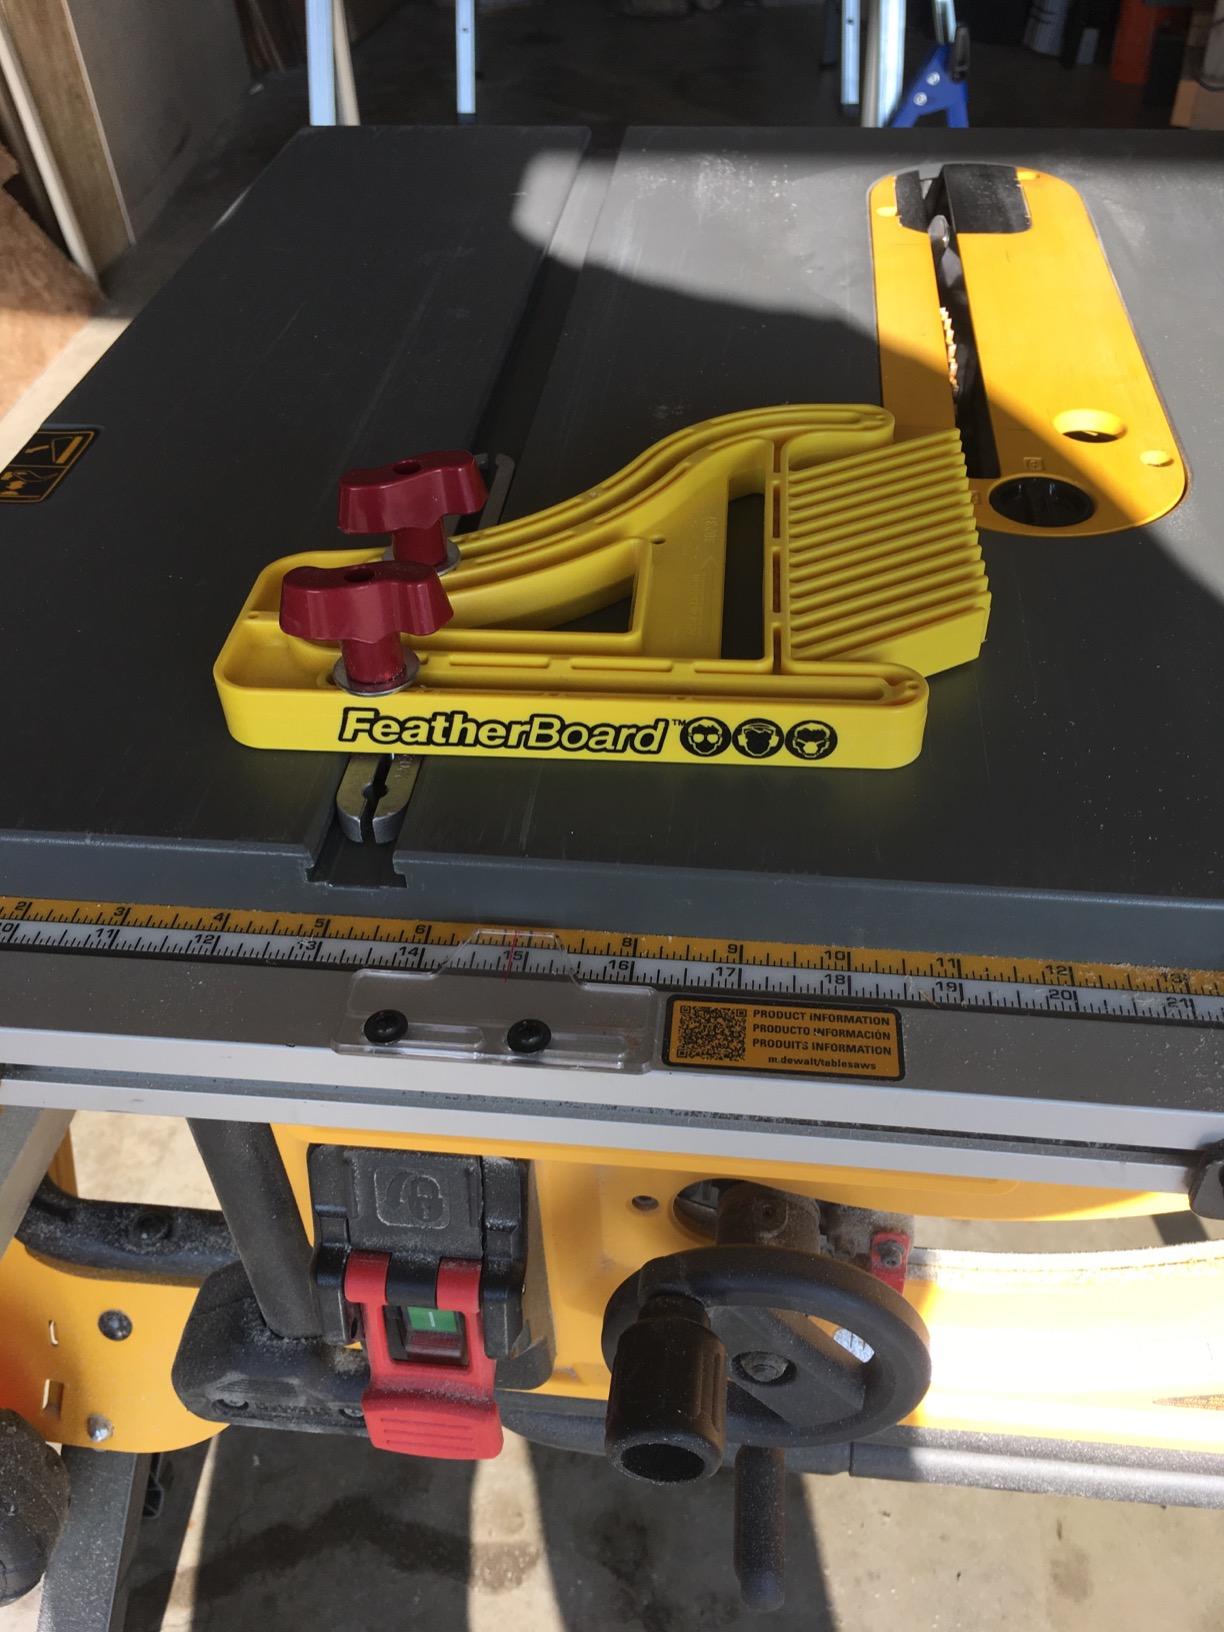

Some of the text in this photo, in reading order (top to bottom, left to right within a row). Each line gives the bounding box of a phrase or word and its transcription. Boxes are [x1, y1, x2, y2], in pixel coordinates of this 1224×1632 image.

[338, 707, 669, 754] FeatherBoard
[15, 901, 27, 911] 2
[114, 907, 126, 917] 3
[213, 912, 225, 922] 4
[314, 918, 326, 928] 5
[415, 925, 426, 935] 6
[621, 937, 632, 947] 8
[727, 944, 738, 955] 9
[824, 950, 846, 961] 10
[936, 957, 957, 968] 11
[1045, 965, 1068, 976] 12
[95, 928, 115, 938] 11
[195, 934, 215, 945] 12
[297, 940, 317, 951] 13
[399, 946, 419, 957] 14
[503, 951, 523, 962] 15
[608, 960, 629, 971] 16
[715, 967, 736, 978] 17
[824, 973, 846, 985] 18
[935, 981, 957, 992] 19
[1049, 989, 1073, 1000] 20
[1166, 996, 1189, 1009] 21
[753, 1008, 890, 1026] PRODUCT INFORMATION
[752, 1024, 891, 1041] PRODUCTO INFORMACIÓN
[752, 1038, 892, 1056] PRODUITS INFORMATION
[768, 1055, 877, 1070] m.dewalt/tablesaws
